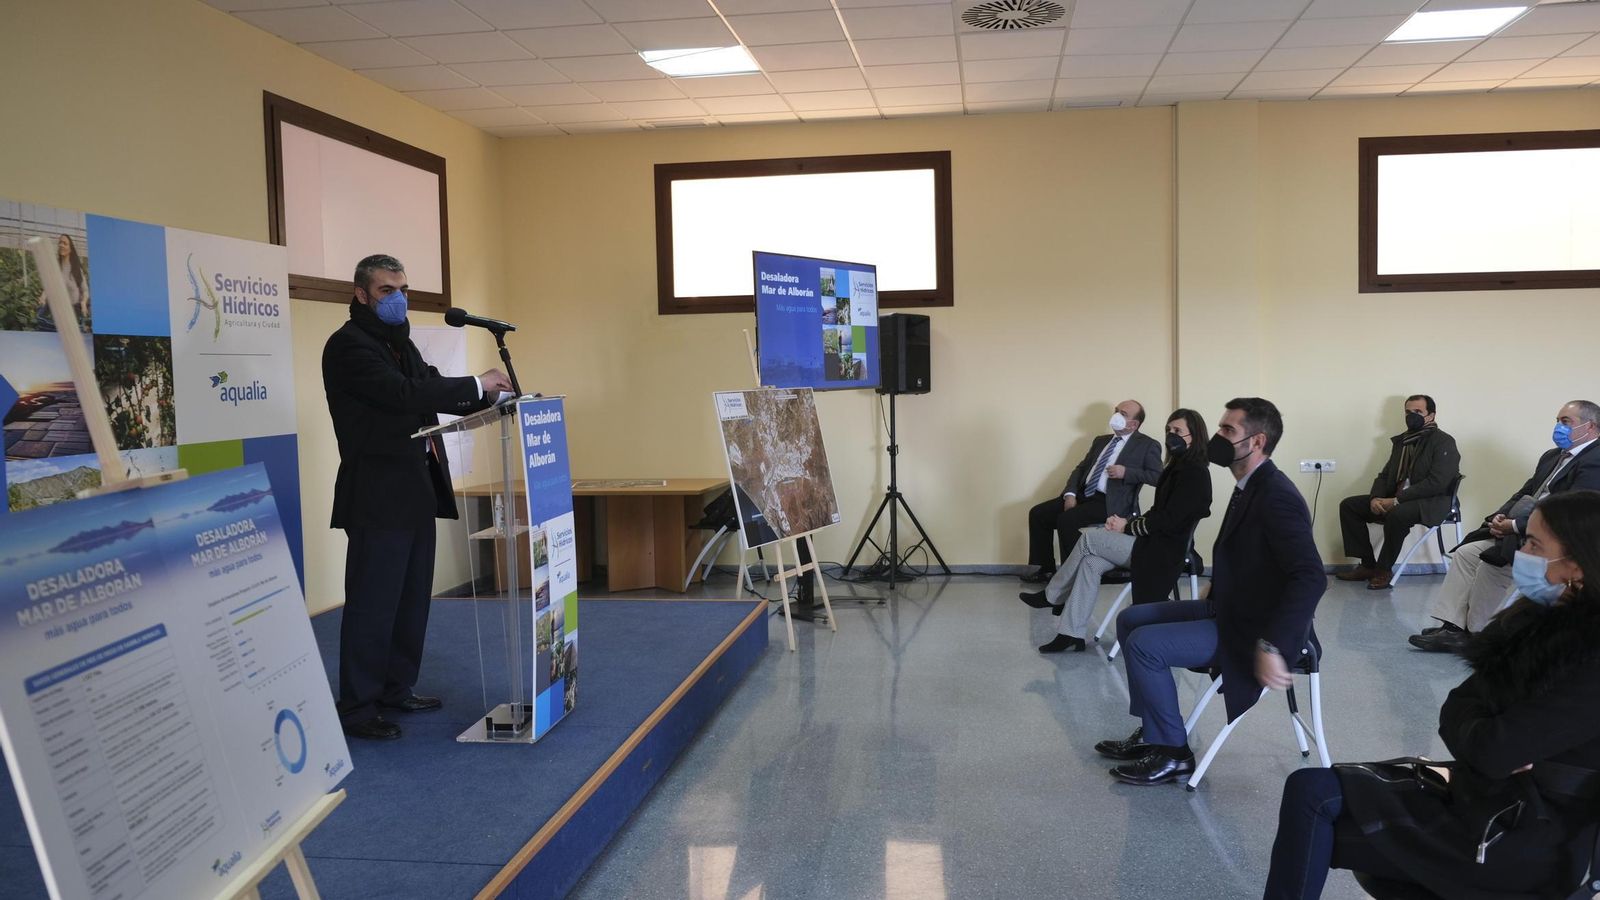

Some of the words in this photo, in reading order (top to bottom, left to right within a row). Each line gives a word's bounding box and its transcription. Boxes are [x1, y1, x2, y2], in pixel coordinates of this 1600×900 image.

[215, 272, 278, 296] Servicios
[761, 271, 799, 283] Desaladora
[761, 285, 776, 295] Mar
[777, 286, 786, 295] de
[788, 286, 814, 297] Alborán
[223, 295, 279, 317] Hídricos
[225, 319, 257, 328] Agricultura
[262, 320, 281, 329] Ciudad
[220, 380, 268, 406] aqualia
[524, 409, 562, 427] Desaladora
[526, 433, 541, 447] Mar
[542, 430, 551, 444] de
[529, 450, 556, 469] Alborán
[195, 518, 256, 547] DESALADORA
[191, 549, 214, 568] MAR
[214, 544, 228, 559] DE
[229, 530, 268, 553] ALBORÁN
[25, 558, 125, 601] DESALADORA
[16, 602, 53, 627] MAR
[55, 594, 78, 615] DE
[80, 572, 143, 607] ALBORÁN
[45, 627, 64, 640] más
[67, 618, 88, 633] agua
[88, 610, 109, 626] para
[110, 601, 133, 615] todos
